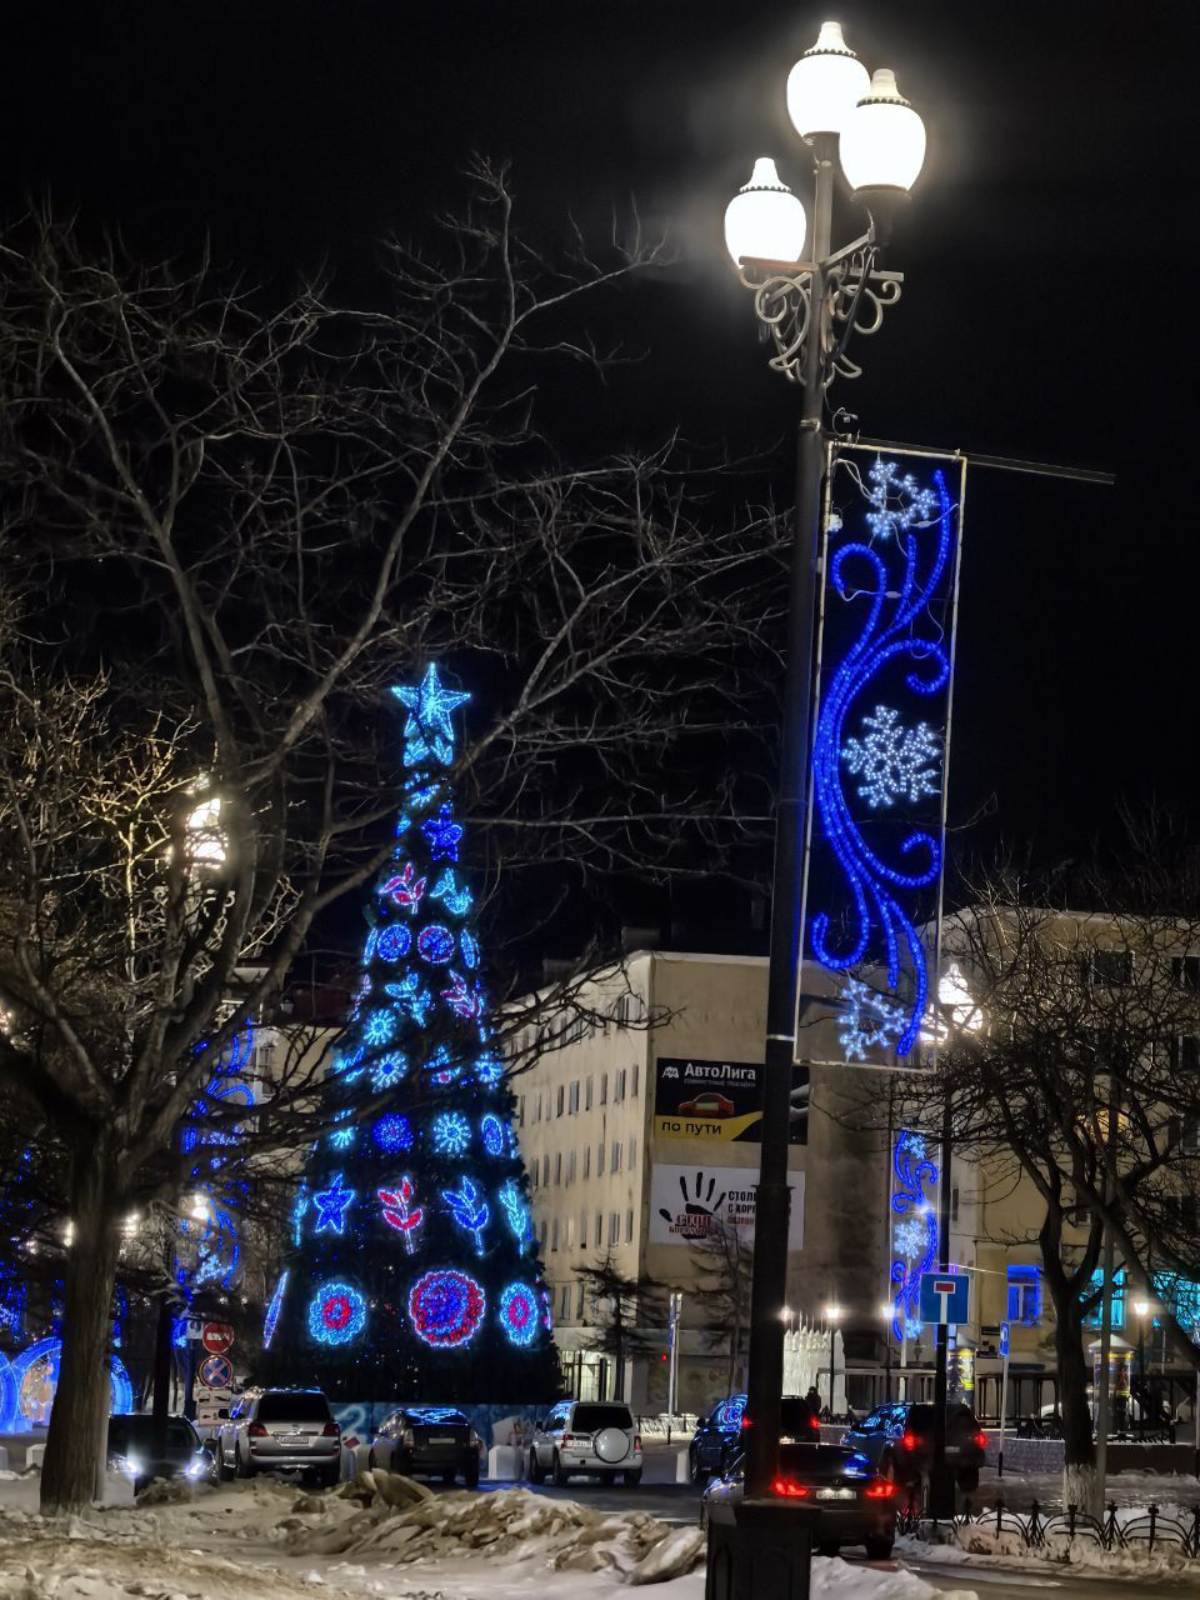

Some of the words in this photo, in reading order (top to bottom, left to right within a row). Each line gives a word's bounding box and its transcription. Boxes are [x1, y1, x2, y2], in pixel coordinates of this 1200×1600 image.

[684, 1062, 756, 1080] АвтоЛига
[661, 1121, 681, 1132] по
[685, 1122, 722, 1136] пути
